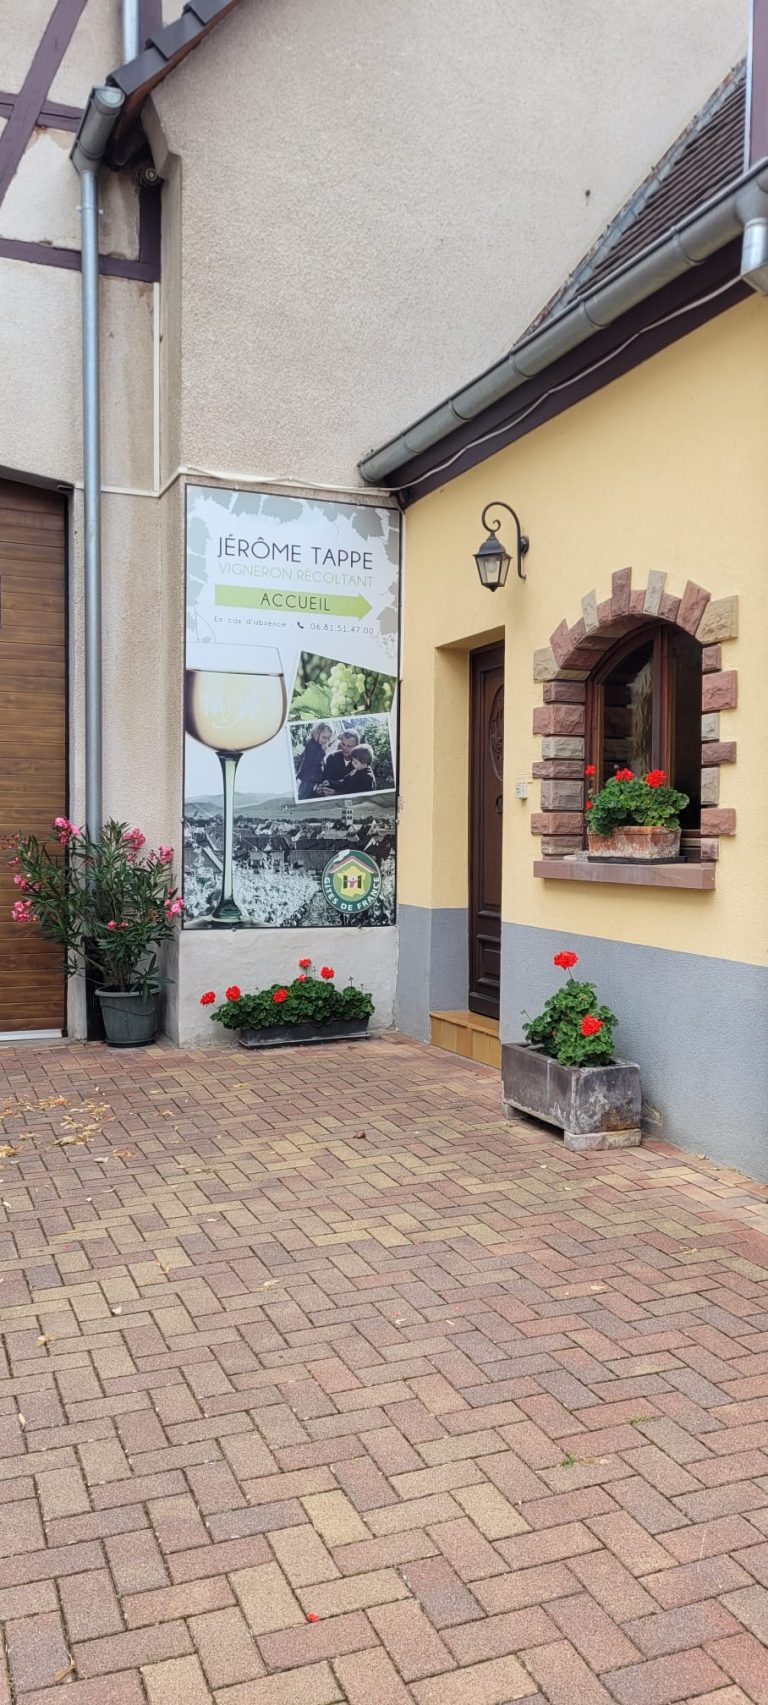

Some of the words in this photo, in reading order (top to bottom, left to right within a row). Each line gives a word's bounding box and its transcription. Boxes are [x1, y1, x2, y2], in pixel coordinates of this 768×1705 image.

[217, 533, 302, 563] JÉRÔME
[311, 546, 374, 570] TAPPE
[218, 562, 292, 580] VIGNERON
[297, 567, 375, 588] RÉCOLTANT
[260, 592, 331, 612] ACCUEIL
[214, 615, 224, 623] En
[227, 617, 242, 625] cas
[245, 617, 287, 629] d'absence
[340, 902, 353, 911] DE
[356, 876, 380, 910] FRANCE
